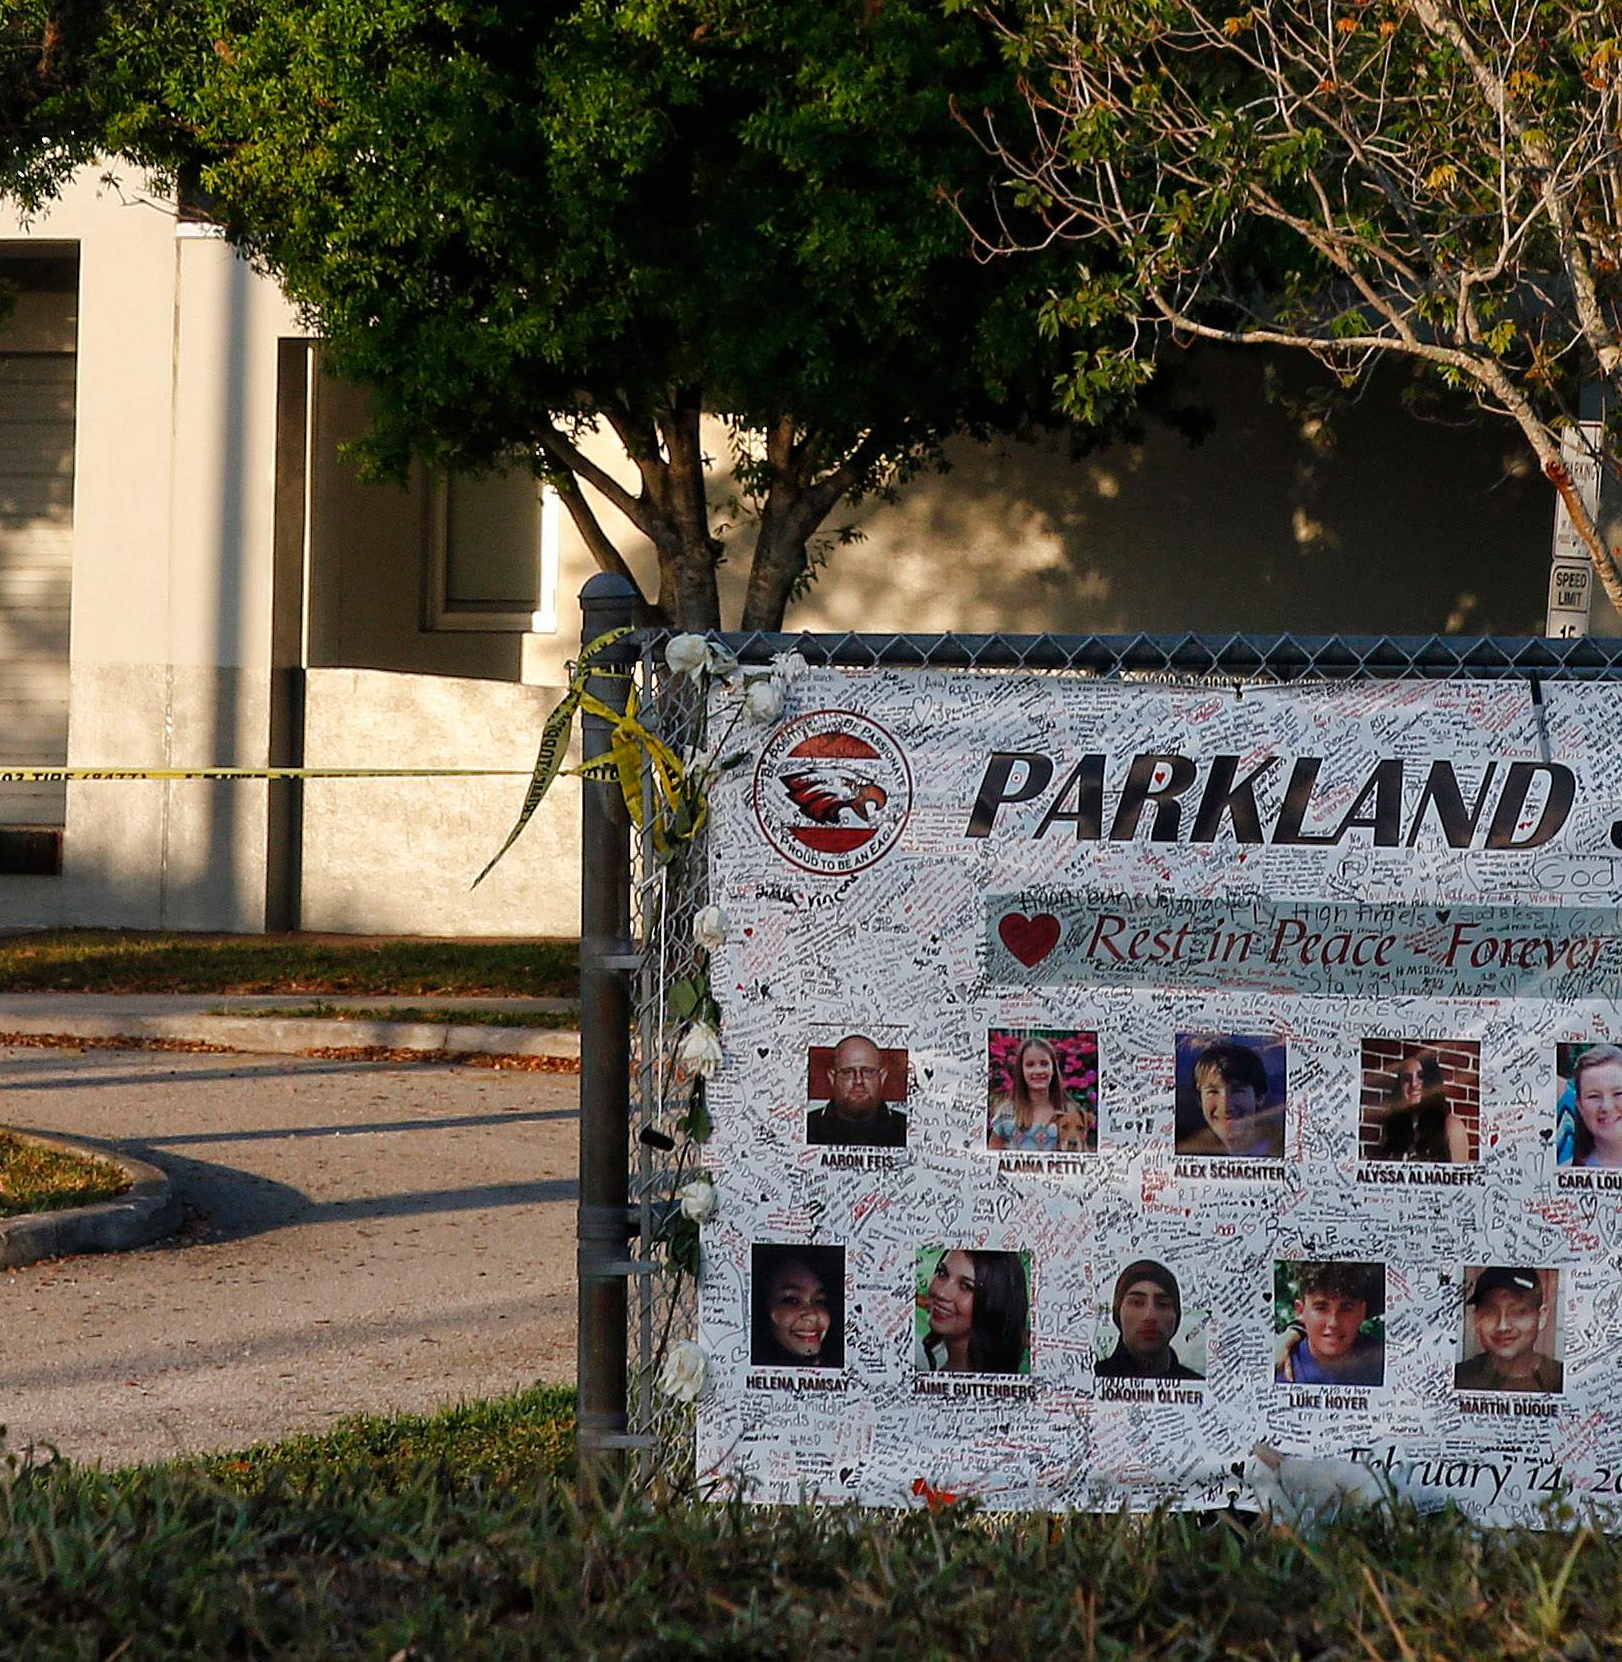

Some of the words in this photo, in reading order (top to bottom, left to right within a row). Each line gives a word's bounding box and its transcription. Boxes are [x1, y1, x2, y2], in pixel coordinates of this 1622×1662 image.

[1555, 571, 1587, 588] SPEED
[1558, 592, 1583, 606] LIMIT
[965, 751, 1577, 849] PARKLAND
[820, 858, 835, 871] TO
[838, 857, 852, 870] BE
[854, 852, 870, 866] AN
[1534, 854, 1615, 890] God
[1085, 913, 1193, 963] Rest
[1206, 916, 1253, 964] in
[1269, 918, 1398, 967] Peace
[1444, 922, 1607, 971] Forever
[821, 1153, 866, 1168] AARON
[867, 1154, 895, 1169] FEIS
[998, 1158, 1044, 1174] ALAINA
[1047, 1160, 1087, 1175] PETTY
[1174, 1163, 1208, 1179] ALEX
[1210, 1164, 1286, 1181] SCHACHTER
[1356, 1170, 1404, 1185] ALYSSA
[1407, 1170, 1475, 1186] ALHADEFF
[1558, 1175, 1593, 1189] CARA
[746, 1376, 797, 1391] HELENA
[798, 1377, 851, 1393] RAMSAY
[911, 1381, 950, 1396] JAIME
[953, 1382, 1037, 1398] GUTTENBERG
[1098, 1388, 1154, 1405] JOAQUIN
[1157, 1390, 1203, 1406] OLIVER
[1288, 1392, 1322, 1408] LUKE
[1325, 1393, 1368, 1410] HOYER
[1459, 1400, 1510, 1416] MARTIN
[1513, 1401, 1558, 1417] DUQUE
[1525, 1464, 1573, 1496] 14,
